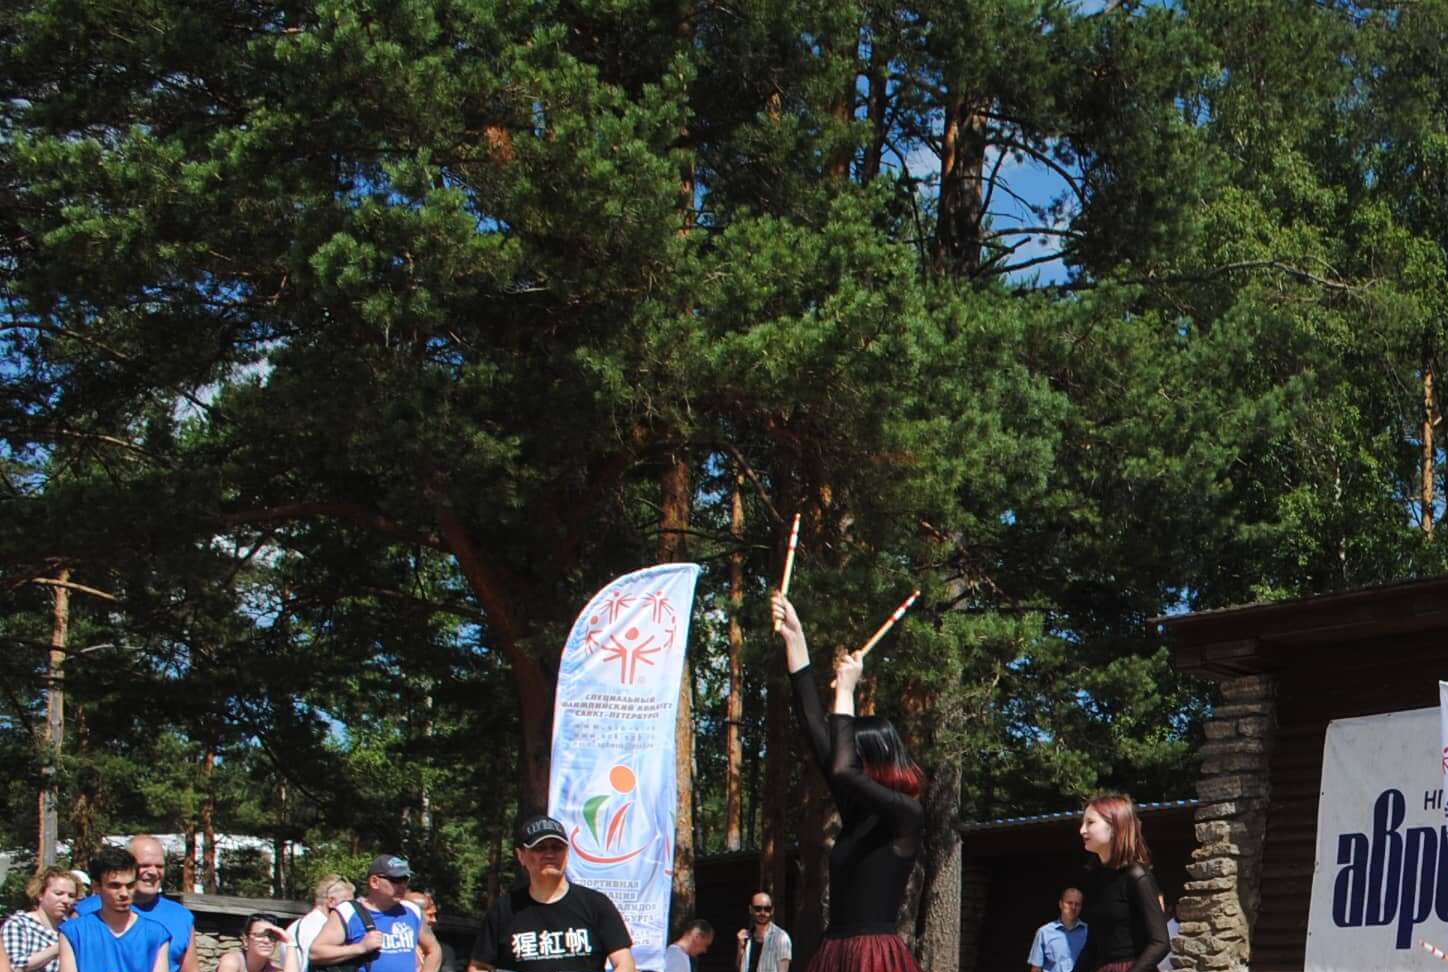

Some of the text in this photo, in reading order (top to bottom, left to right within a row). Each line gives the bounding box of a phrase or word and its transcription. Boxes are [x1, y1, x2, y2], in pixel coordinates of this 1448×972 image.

[382, 930, 415, 950] OCHI
[512, 927, 592, 958] 猩紅帆
